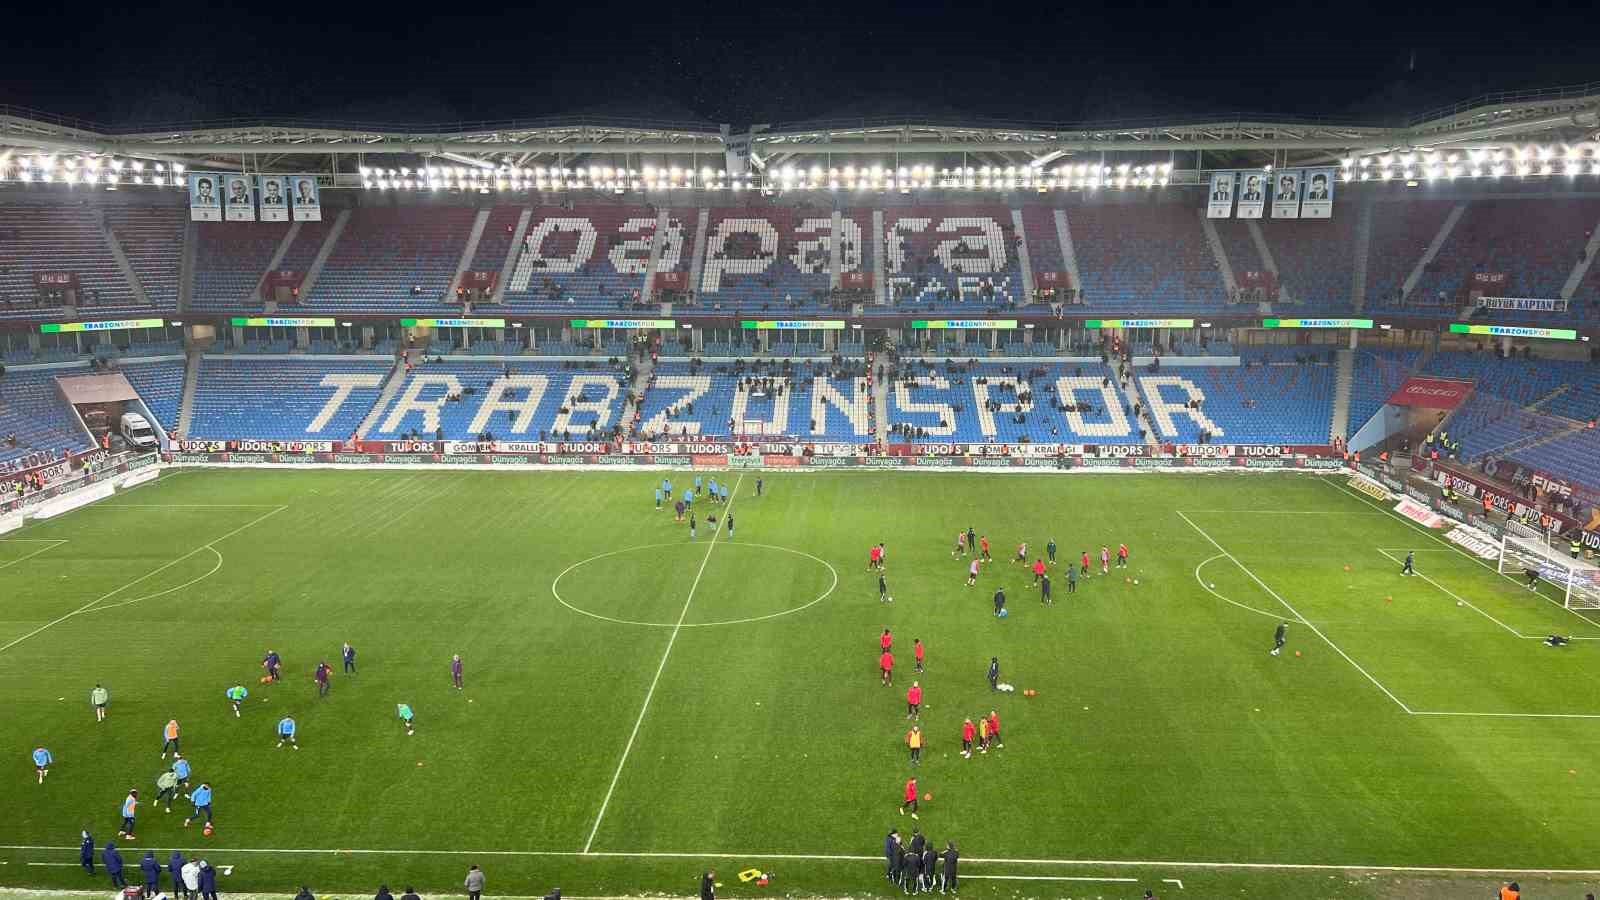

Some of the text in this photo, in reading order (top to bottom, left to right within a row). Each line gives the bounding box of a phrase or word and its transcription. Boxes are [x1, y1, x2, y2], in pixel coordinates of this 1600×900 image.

[305, 374, 1224, 436] TRABZONSPOR
[687, 444, 727, 453] TUDORS
[1099, 446, 1143, 455] TUDORS
